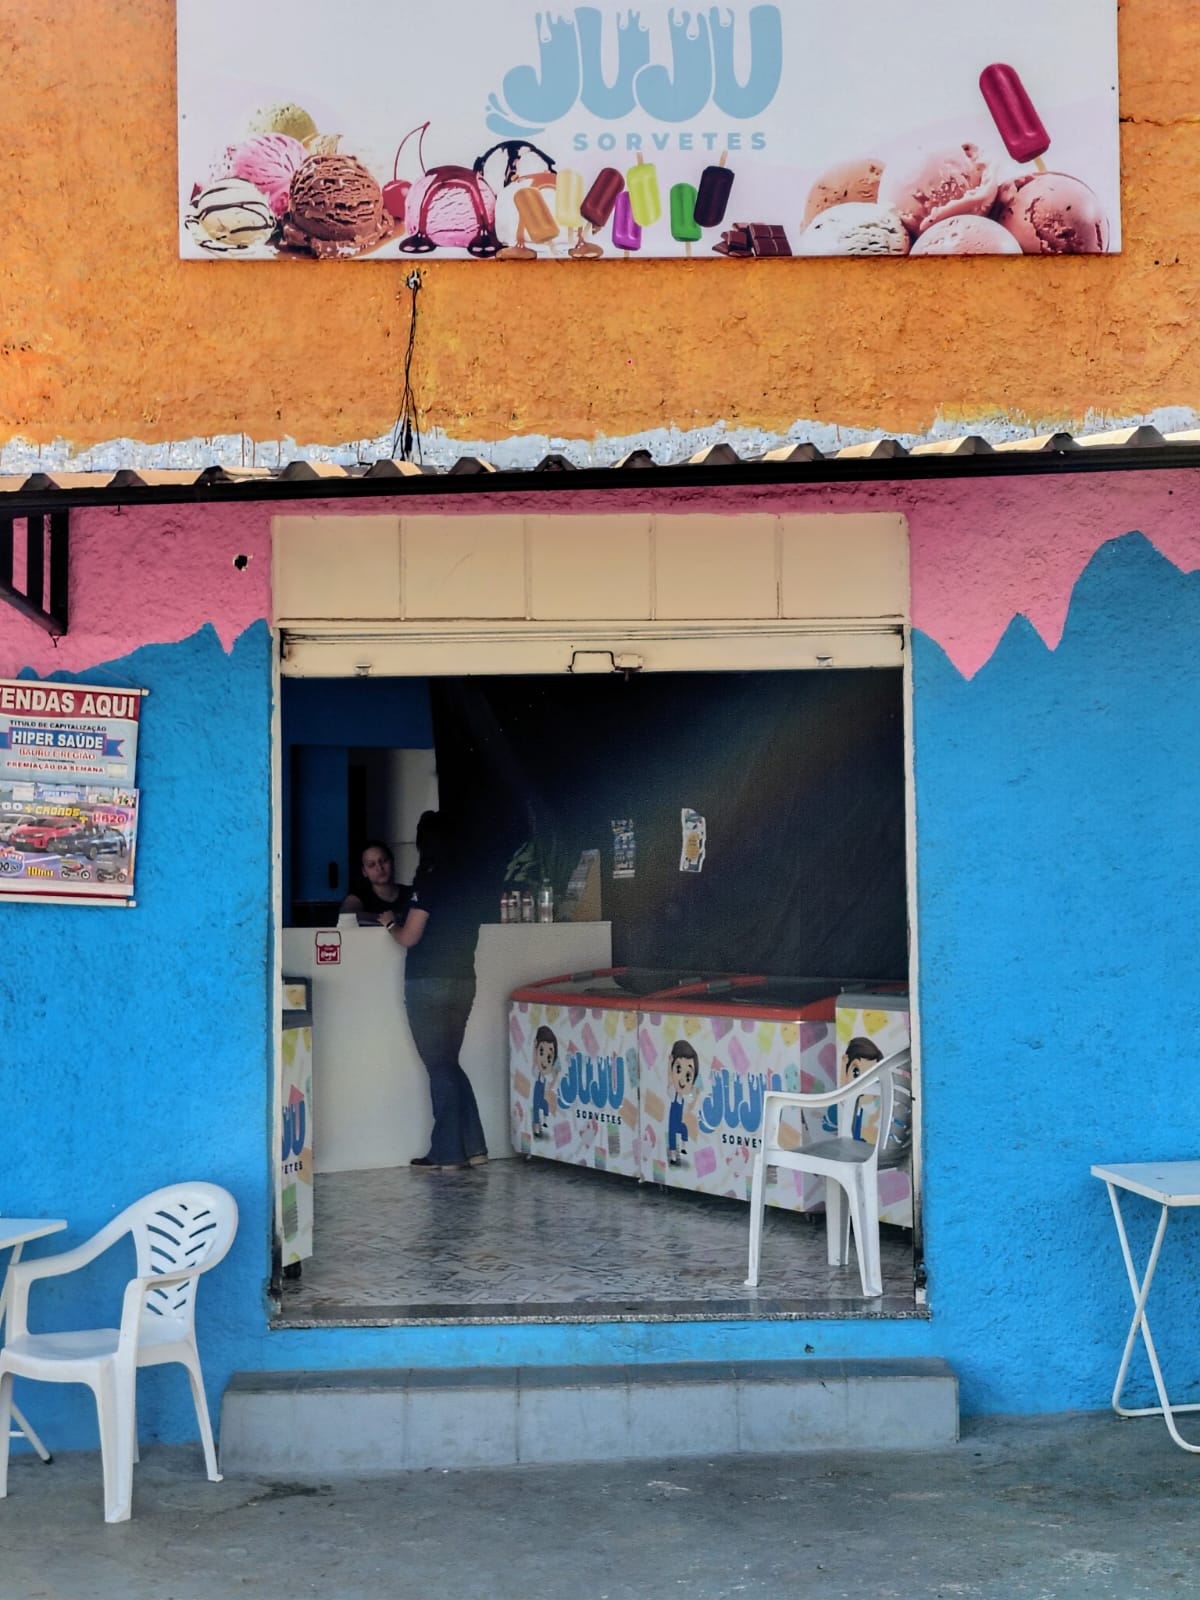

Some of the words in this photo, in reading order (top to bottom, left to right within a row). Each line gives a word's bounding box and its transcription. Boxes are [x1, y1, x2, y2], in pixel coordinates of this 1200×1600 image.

[502, 5, 783, 123] JUJU
[573, 132, 767, 151] SORVETES
[0, 688, 75, 713] ENDAS
[80, 694, 135, 717] AQUI
[12, 730, 54, 746] HIPER
[57, 732, 104, 749] SAÚDE
[560, 1052, 624, 1110] JUJU
[576, 1109, 622, 1125] SORVETES
